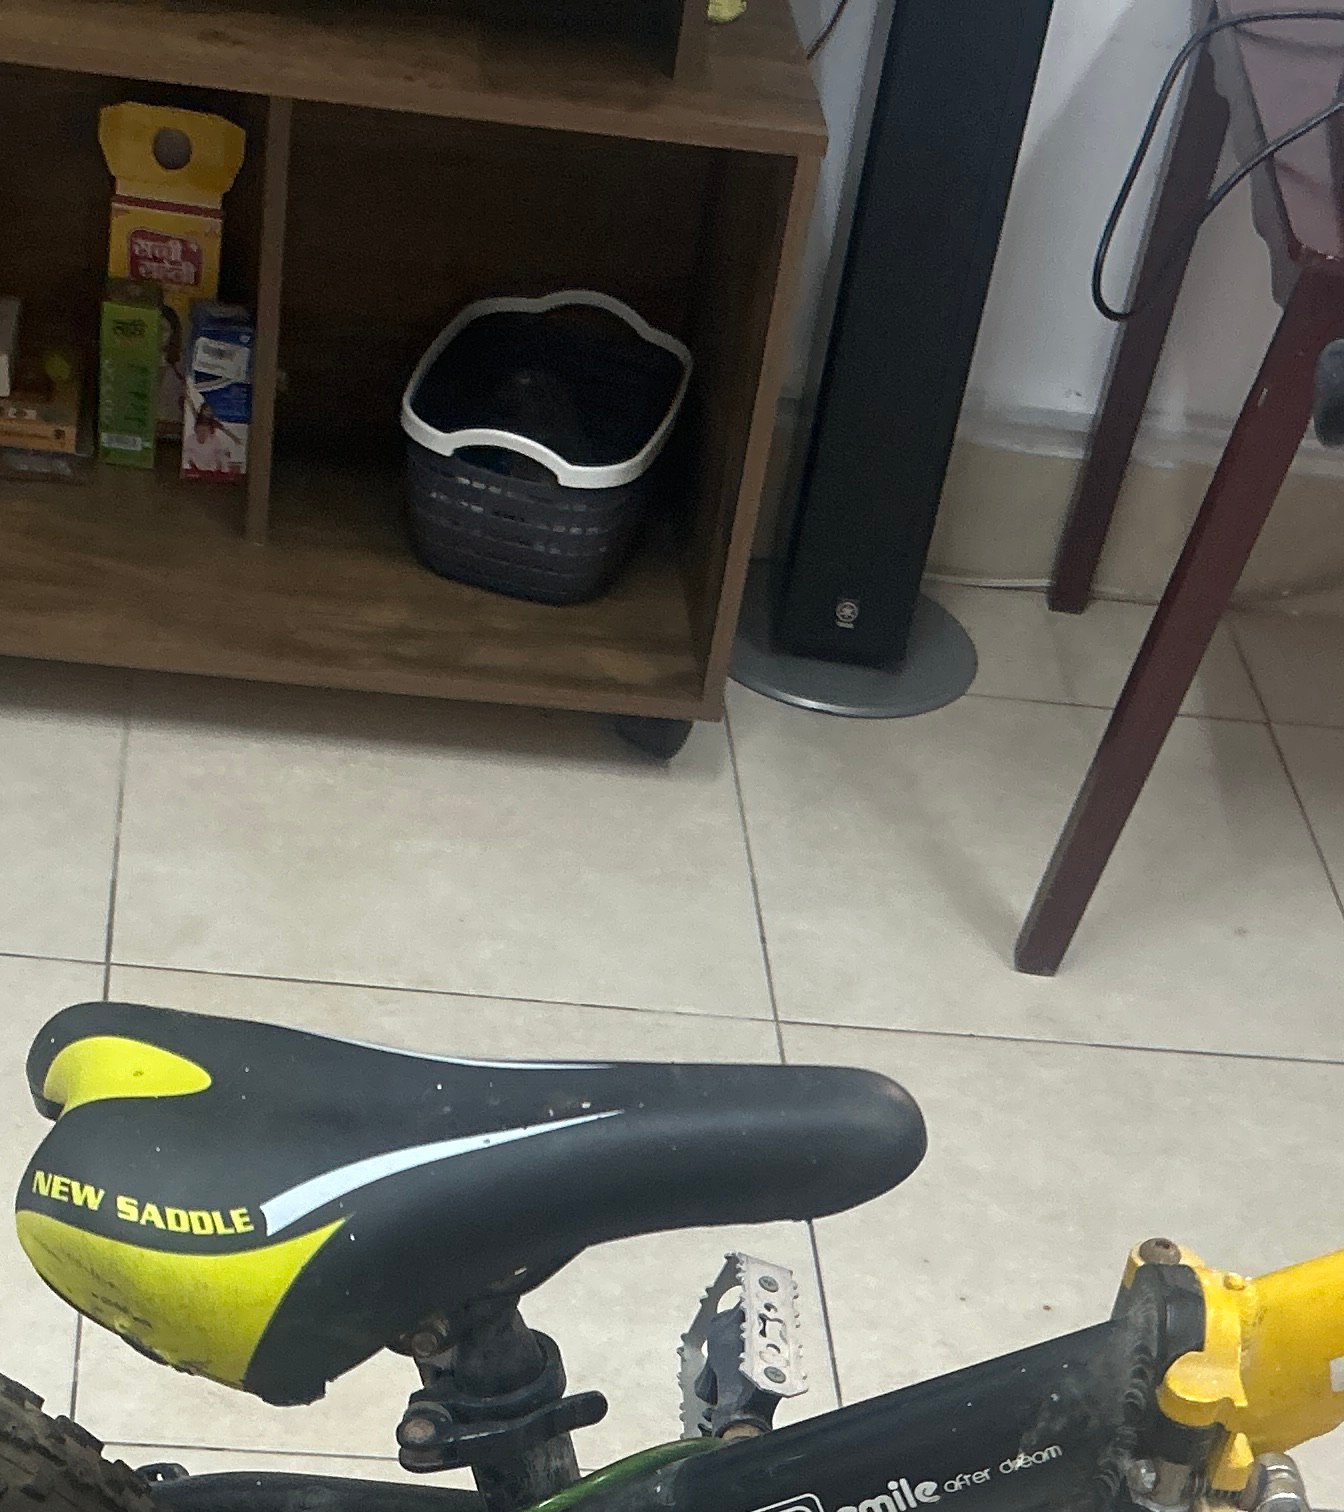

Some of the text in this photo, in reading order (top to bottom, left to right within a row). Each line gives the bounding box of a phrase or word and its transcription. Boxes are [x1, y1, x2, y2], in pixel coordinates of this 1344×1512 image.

[32, 1170, 255, 1235] NEW SADDLE
[943, 1467, 991, 1493] after
